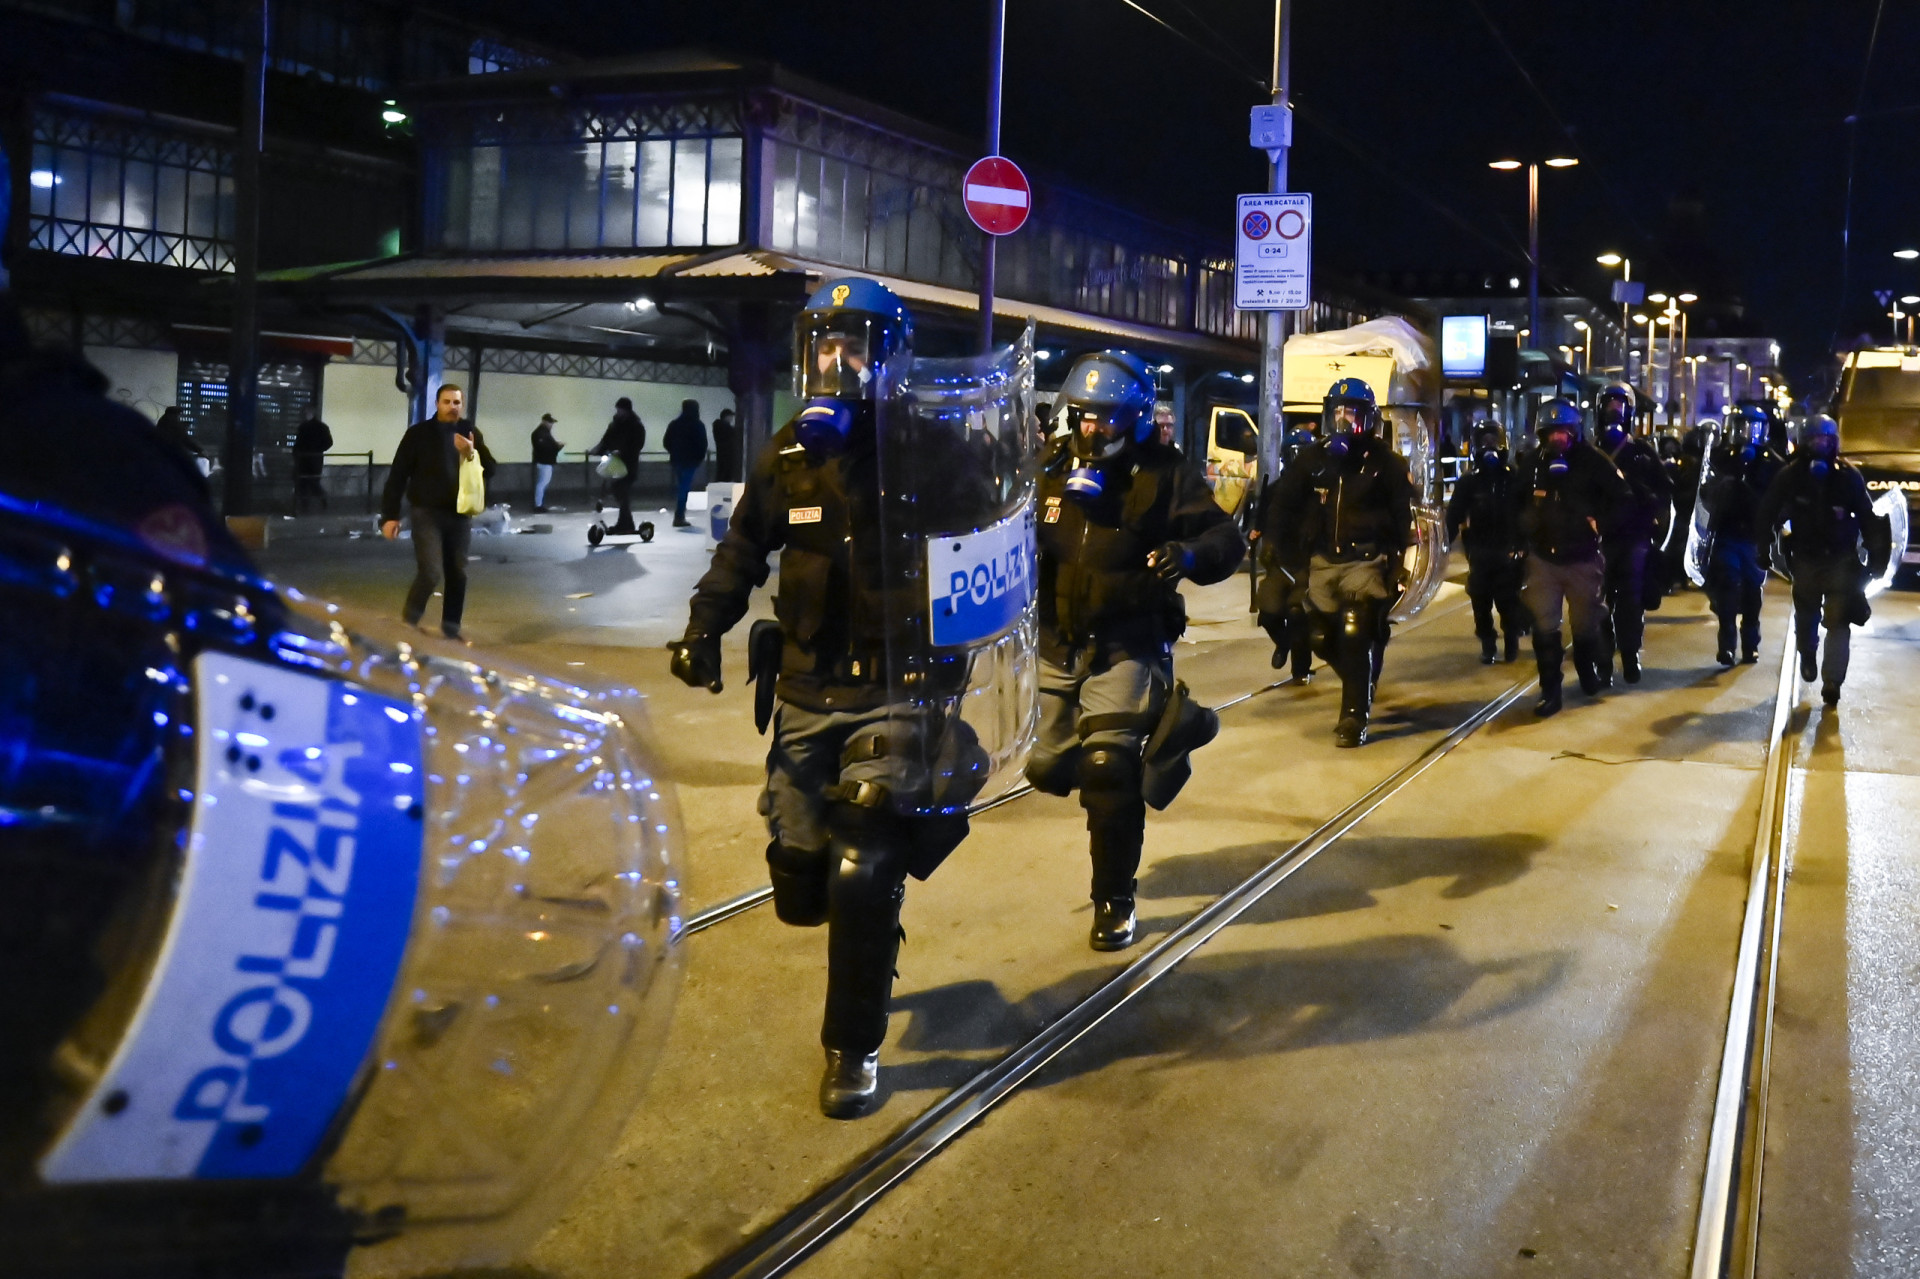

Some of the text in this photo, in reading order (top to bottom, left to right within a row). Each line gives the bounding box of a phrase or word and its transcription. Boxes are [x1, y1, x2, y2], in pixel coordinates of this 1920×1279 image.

[1866, 480, 1920, 491] CARAB
[791, 509, 820, 521] POLIZIA
[173, 740, 364, 1124] POLIZIA
